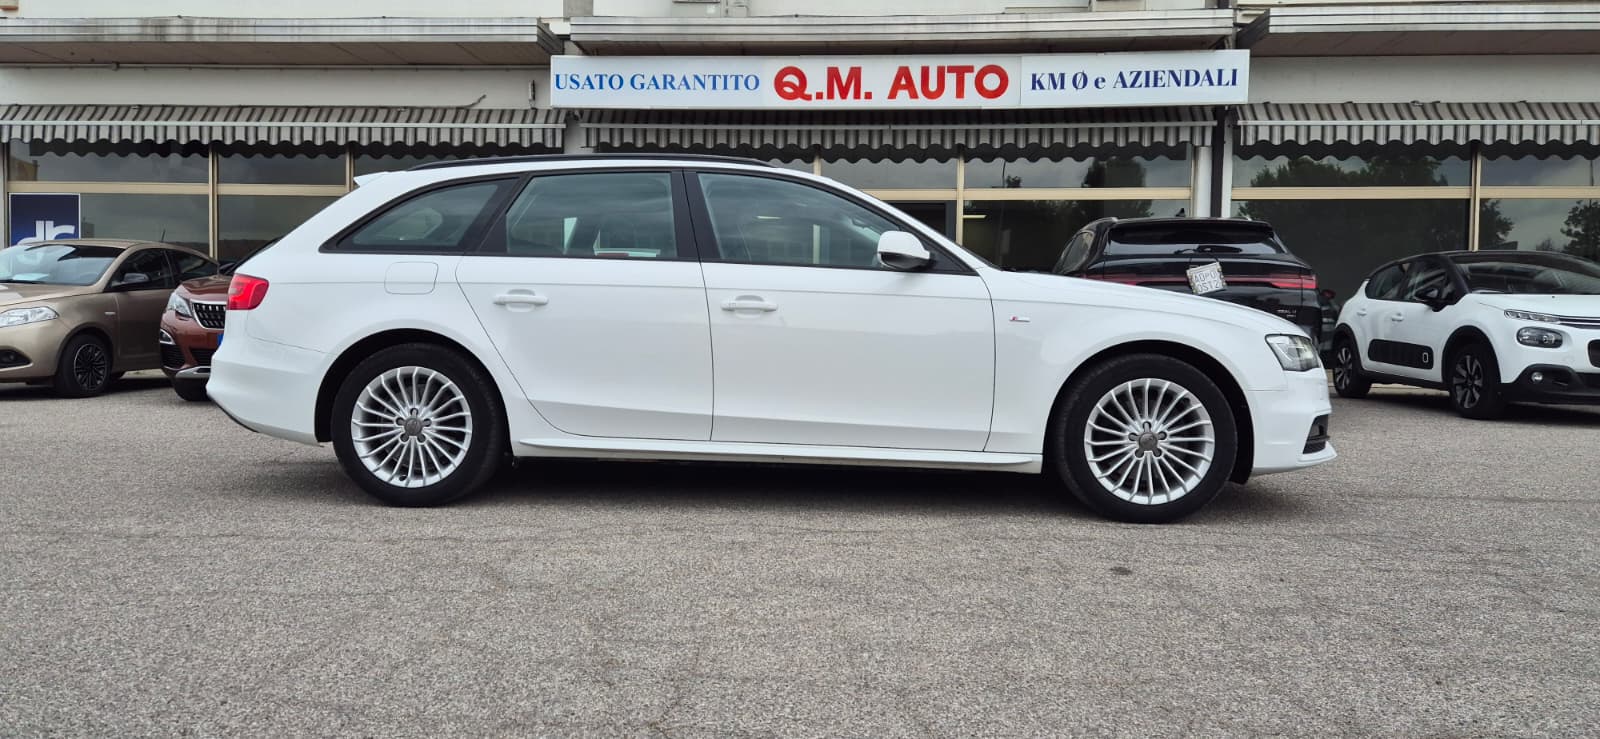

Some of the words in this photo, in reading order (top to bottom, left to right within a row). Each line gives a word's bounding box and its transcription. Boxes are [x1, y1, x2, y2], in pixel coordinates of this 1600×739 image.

[555, 74, 624, 90] USATO
[630, 74, 760, 90] GARANTITO
[774, 66, 872, 101] Q.M.
[887, 64, 1009, 100] AUTO
[1031, 72, 1066, 91] KM
[1093, 76, 1107, 90] e
[1112, 68, 1238, 89] AZIENDALI
